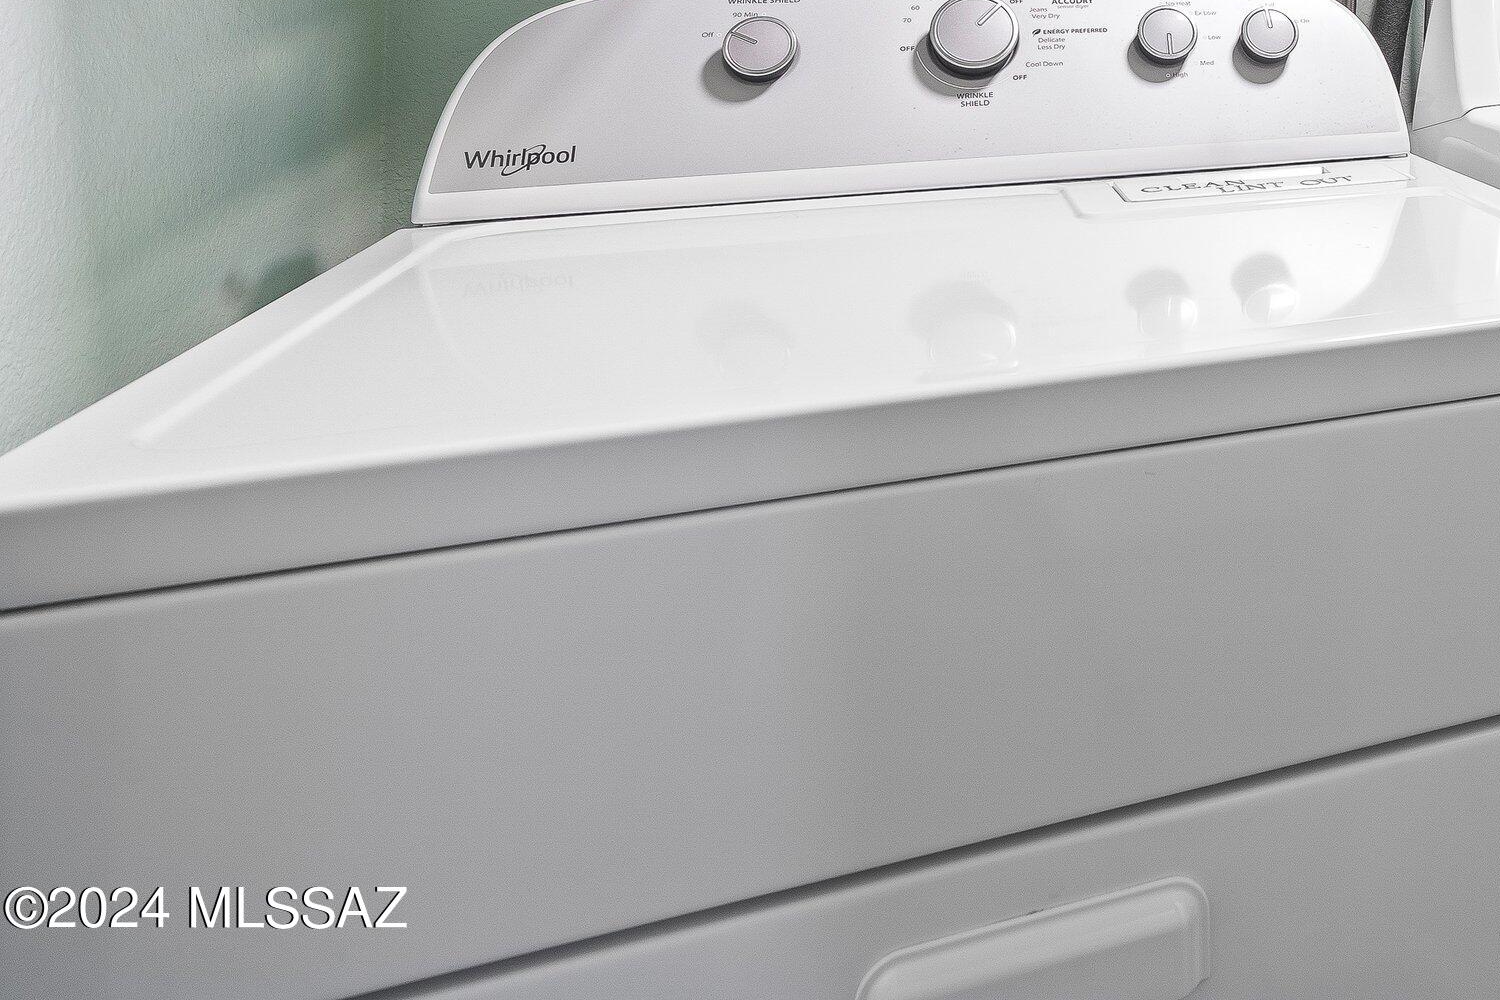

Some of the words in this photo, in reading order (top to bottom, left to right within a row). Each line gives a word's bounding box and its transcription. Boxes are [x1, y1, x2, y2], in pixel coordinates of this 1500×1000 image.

[1173, 71, 1188, 79] High
[956, 92, 994, 100] WRINKLE
[960, 100, 990, 108] SHIELD
[464, 144, 576, 176] Whirlpool
[1141, 179, 1247, 193] CLEAN
[1216, 180, 1284, 194] LINT
[1300, 175, 1352, 187] OUT
